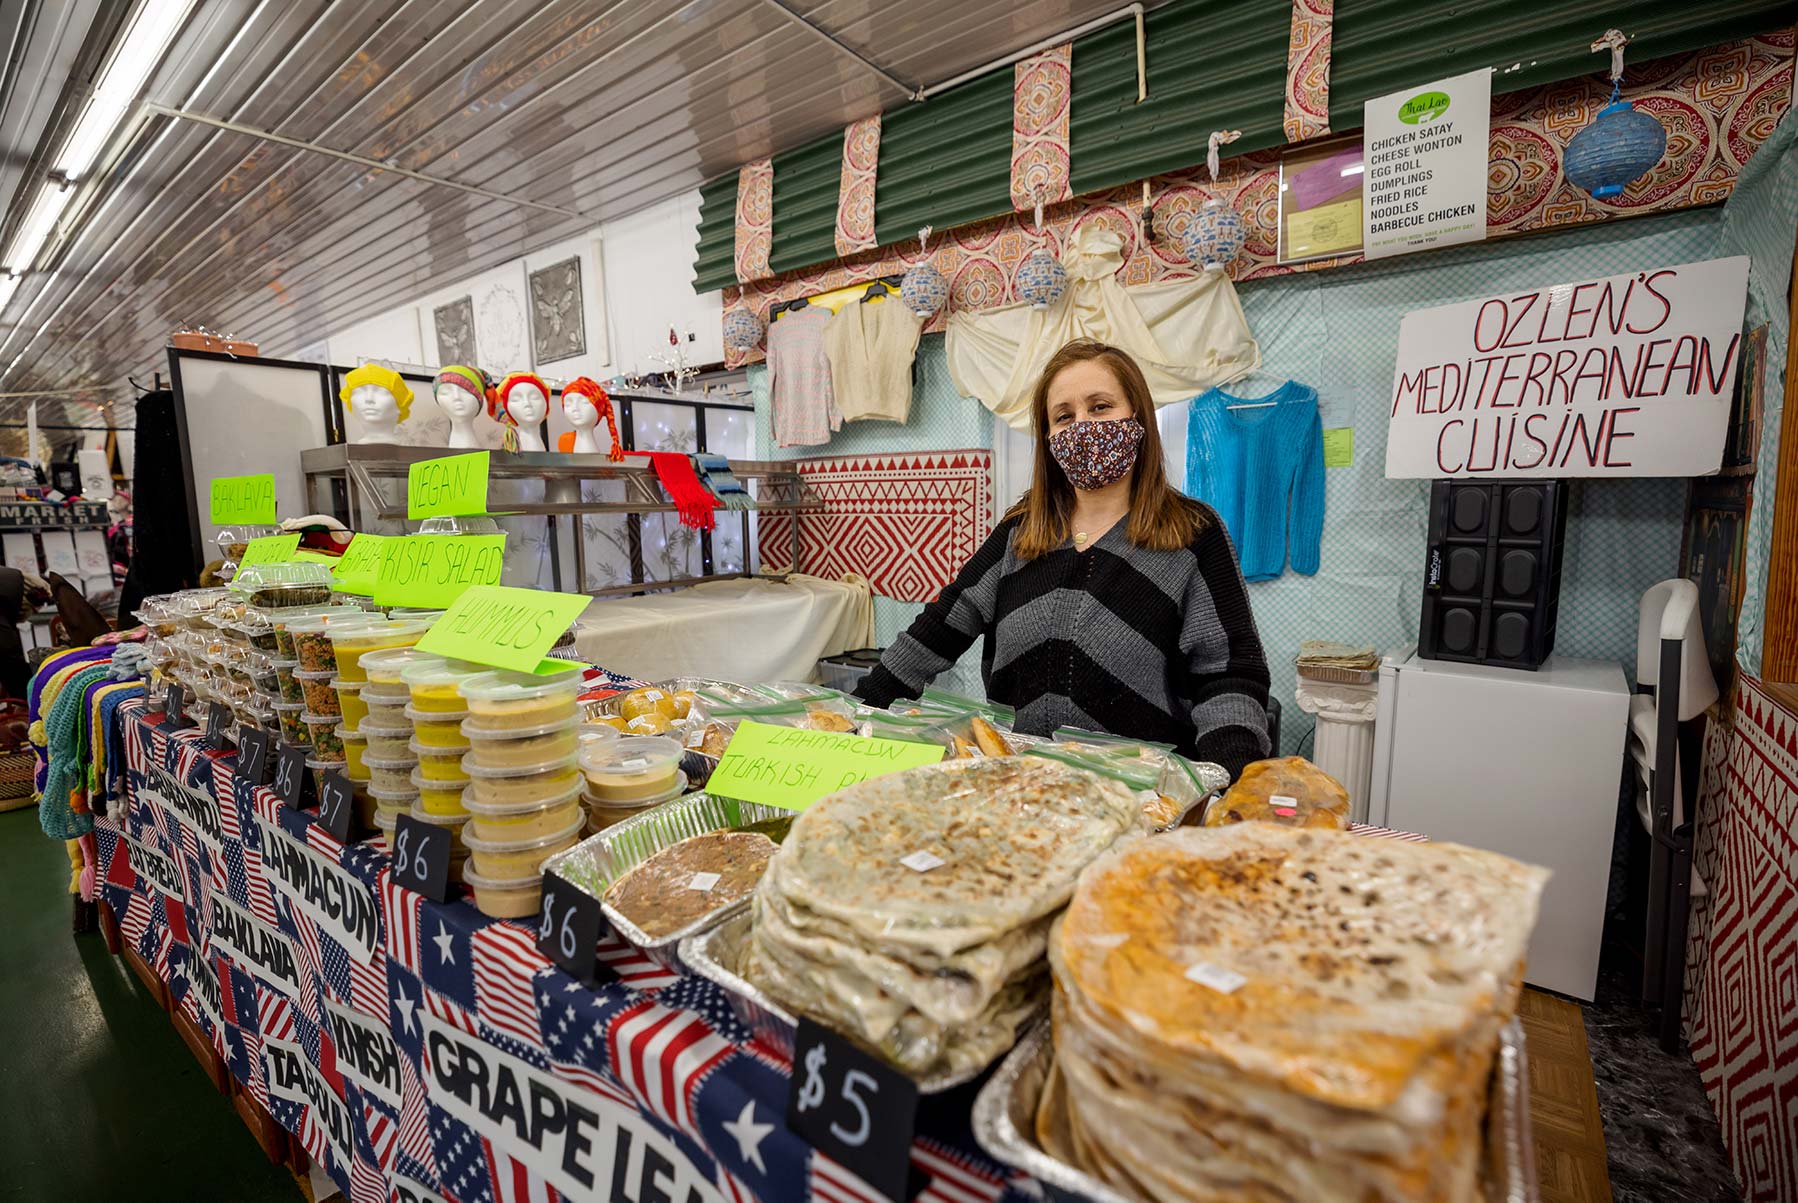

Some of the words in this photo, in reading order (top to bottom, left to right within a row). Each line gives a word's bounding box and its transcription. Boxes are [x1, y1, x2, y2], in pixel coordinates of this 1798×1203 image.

[1402, 102, 1426, 114] Thai
[1371, 132, 1416, 151] CHICKEN
[1419, 122, 1454, 140] SATAY
[1371, 147, 1410, 165] CHEESE
[1414, 135, 1462, 155] WONTON
[1371, 166, 1391, 179] EGG
[1394, 159, 1422, 174] ROLL
[1371, 170, 1433, 193] DUMPLINGS
[1370, 201, 1419, 220] NOODLES
[1371, 192, 1400, 206] FRIED
[1404, 185, 1428, 200] RICE
[1370, 213, 1424, 234] BARBECUE
[1428, 204, 1475, 223] CHICKEN
[1474, 270, 1677, 354] OZLEN'S
[1392, 333, 1742, 418] MEDITERRANEAN
[1437, 407, 1641, 474] CUISINE
[212, 481, 273, 516] BAKLAVA
[411, 461, 471, 510] VEGAN
[0, 506, 99, 518] MARKET
[382, 541, 434, 587] KISIR
[438, 544, 503, 586] SALAD
[455, 596, 555, 650] HUMMUS
[767, 729, 908, 761] LAHMACUN
[721, 754, 824, 789] TURKISH
[260, 829, 376, 951] LAHMACUN
[213, 896, 300, 990] BAKLAVA
[428, 1029, 600, 1192] GRAPE
[609, 1124, 704, 1203] LE
